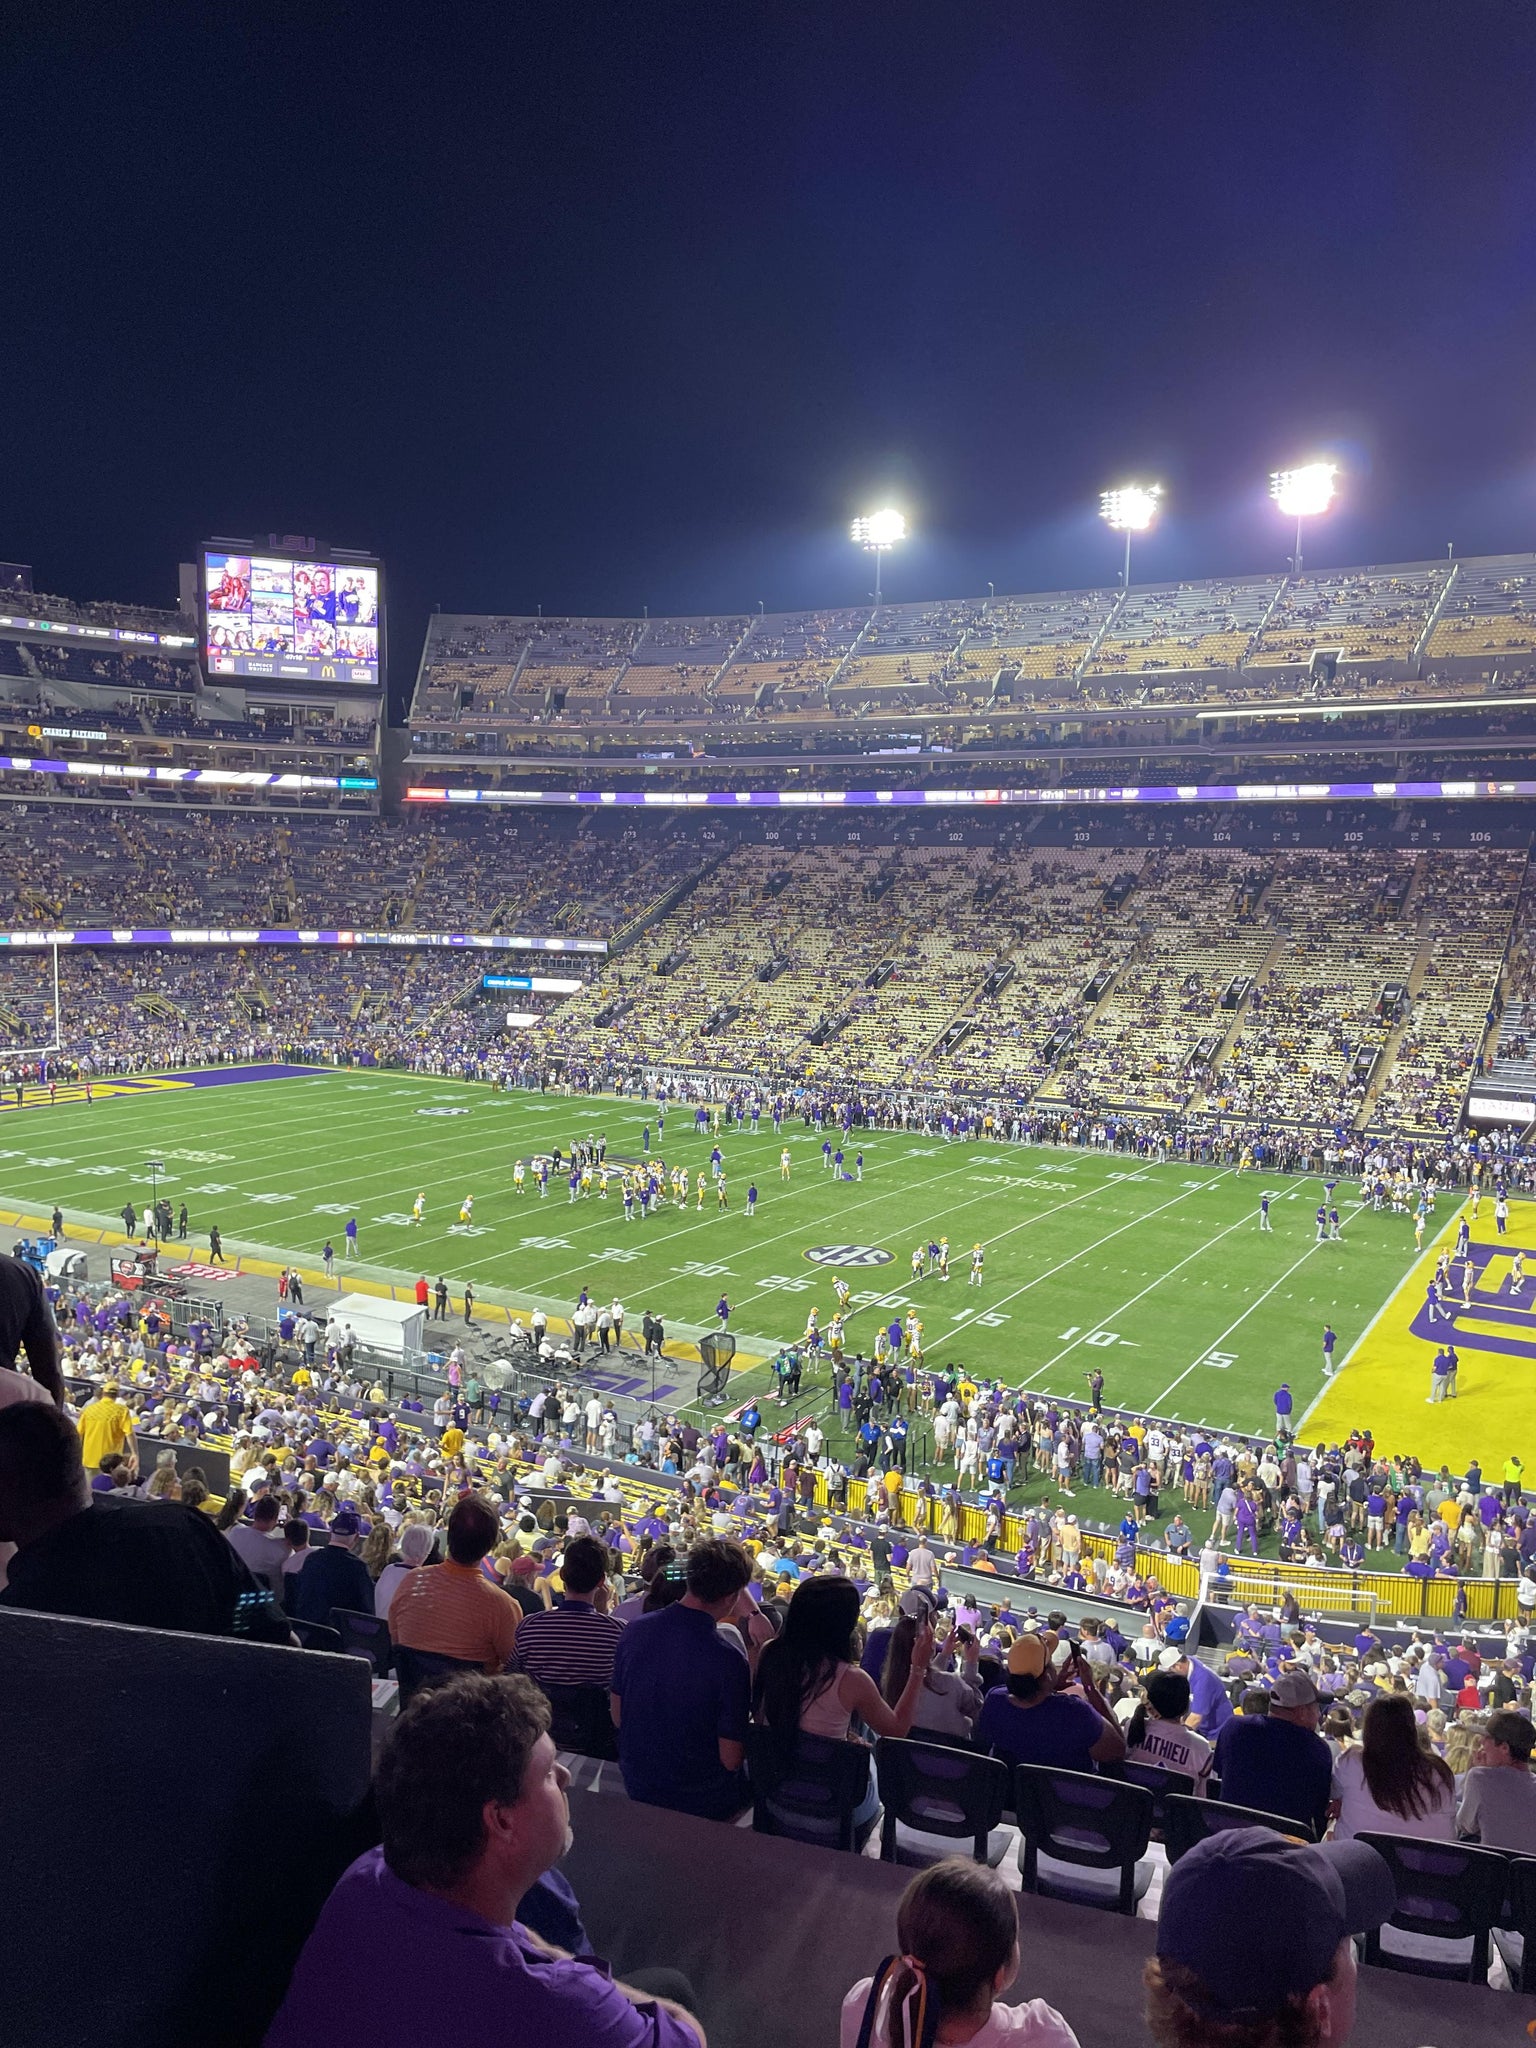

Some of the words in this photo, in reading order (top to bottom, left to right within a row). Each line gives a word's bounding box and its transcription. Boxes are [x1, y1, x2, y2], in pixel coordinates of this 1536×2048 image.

[269, 533, 316, 553] LSU
[42, 727, 70, 738] CHARLES
[71, 730, 107, 741] ALEXANDER
[503, 828, 518, 836] 422
[702, 832, 716, 840] 424
[766, 832, 779, 840] 100
[847, 833, 860, 841] 101
[949, 833, 963, 841] 102
[1074, 833, 1089, 841] 103
[1213, 833, 1231, 841] 104
[1343, 832, 1364, 841] 105
[1470, 832, 1491, 841] 106
[1258, 1190, 1299, 1200] 10
[519, 1236, 570, 1250] 40
[588, 1247, 648, 1263] 35
[808, 1245, 889, 1266] SEC
[669, 1261, 730, 1277] 30
[755, 1275, 818, 1292] 25
[848, 1290, 911, 1308] 20
[950, 1308, 1013, 1328] 15
[1058, 1327, 1121, 1347] 10
[1203, 1351, 1239, 1368] 5
[459, 1409, 465, 1419] 9
[1150, 1437, 1160, 1447] 33
[1171, 1449, 1181, 1457] 33
[1073, 1577, 1079, 1590] 1
[1145, 1646, 1150, 1660] 1
[1136, 1734, 1190, 1766] ATHIEU
